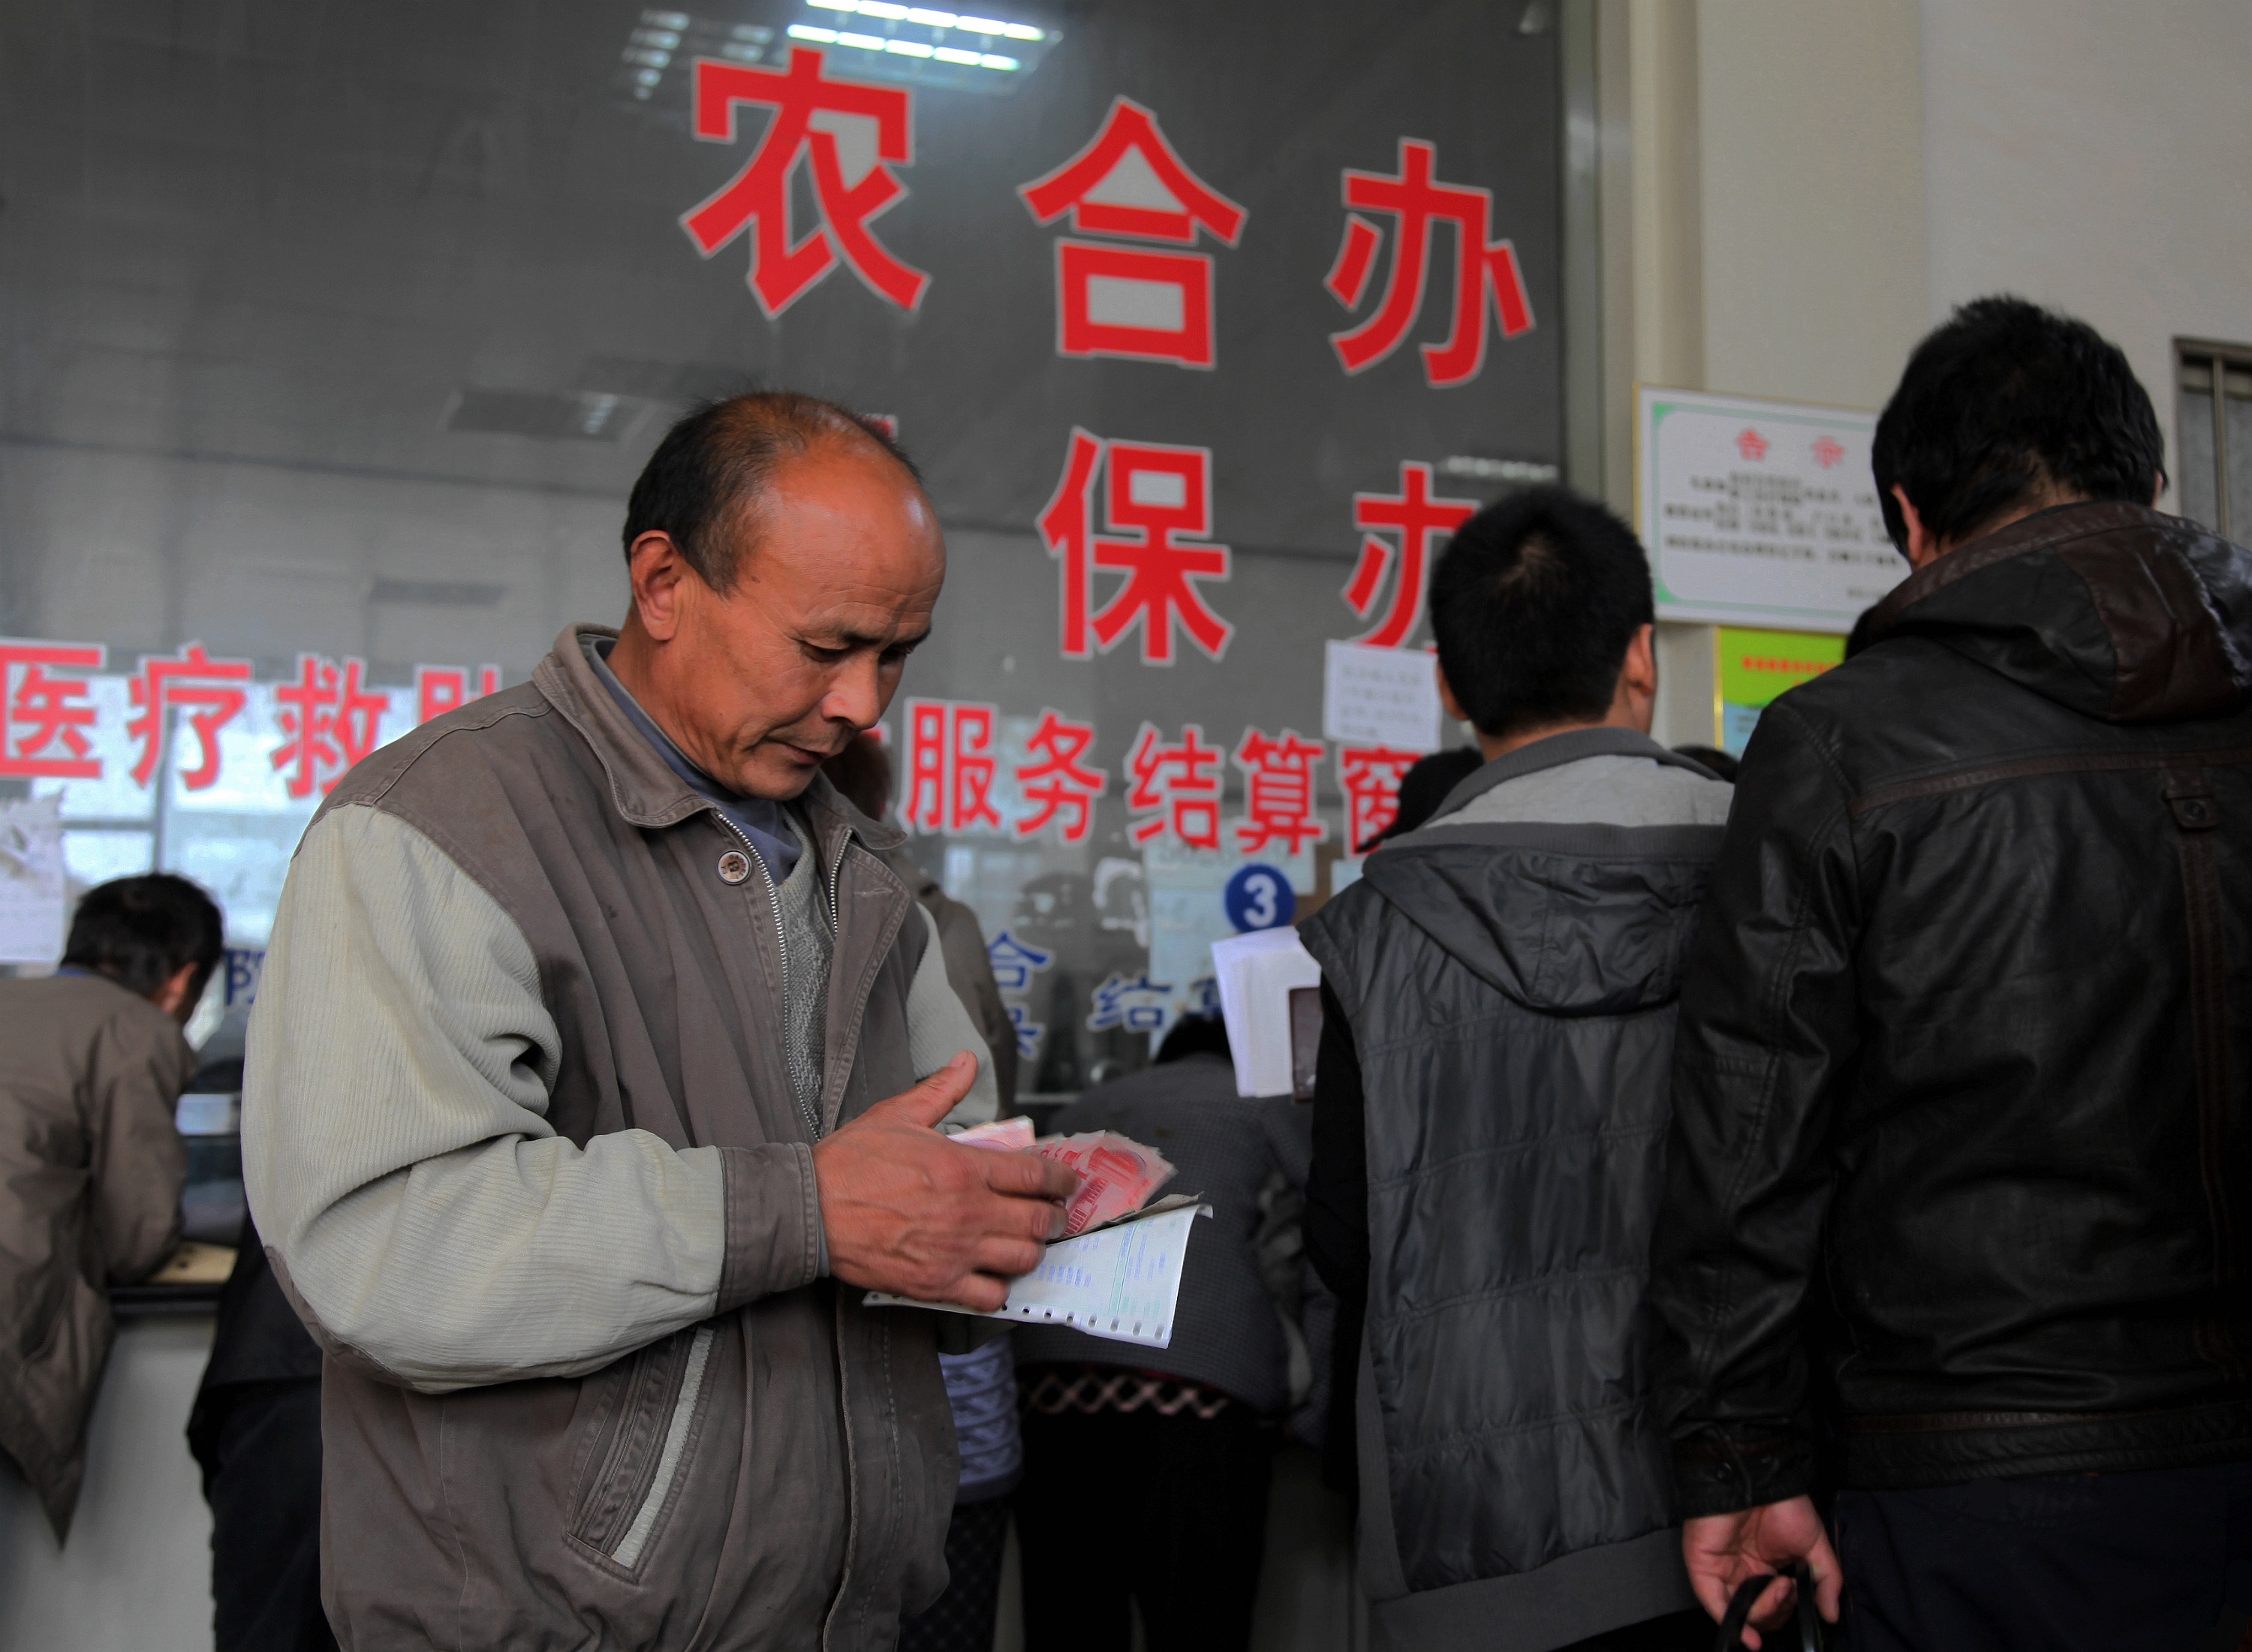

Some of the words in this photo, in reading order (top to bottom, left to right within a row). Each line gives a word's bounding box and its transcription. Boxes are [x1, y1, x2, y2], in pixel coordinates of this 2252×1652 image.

[684, 45, 1533, 387] 农合办
[863, 703, 1424, 856] 服务结算窗
[1242, 873, 1279, 928] 3
